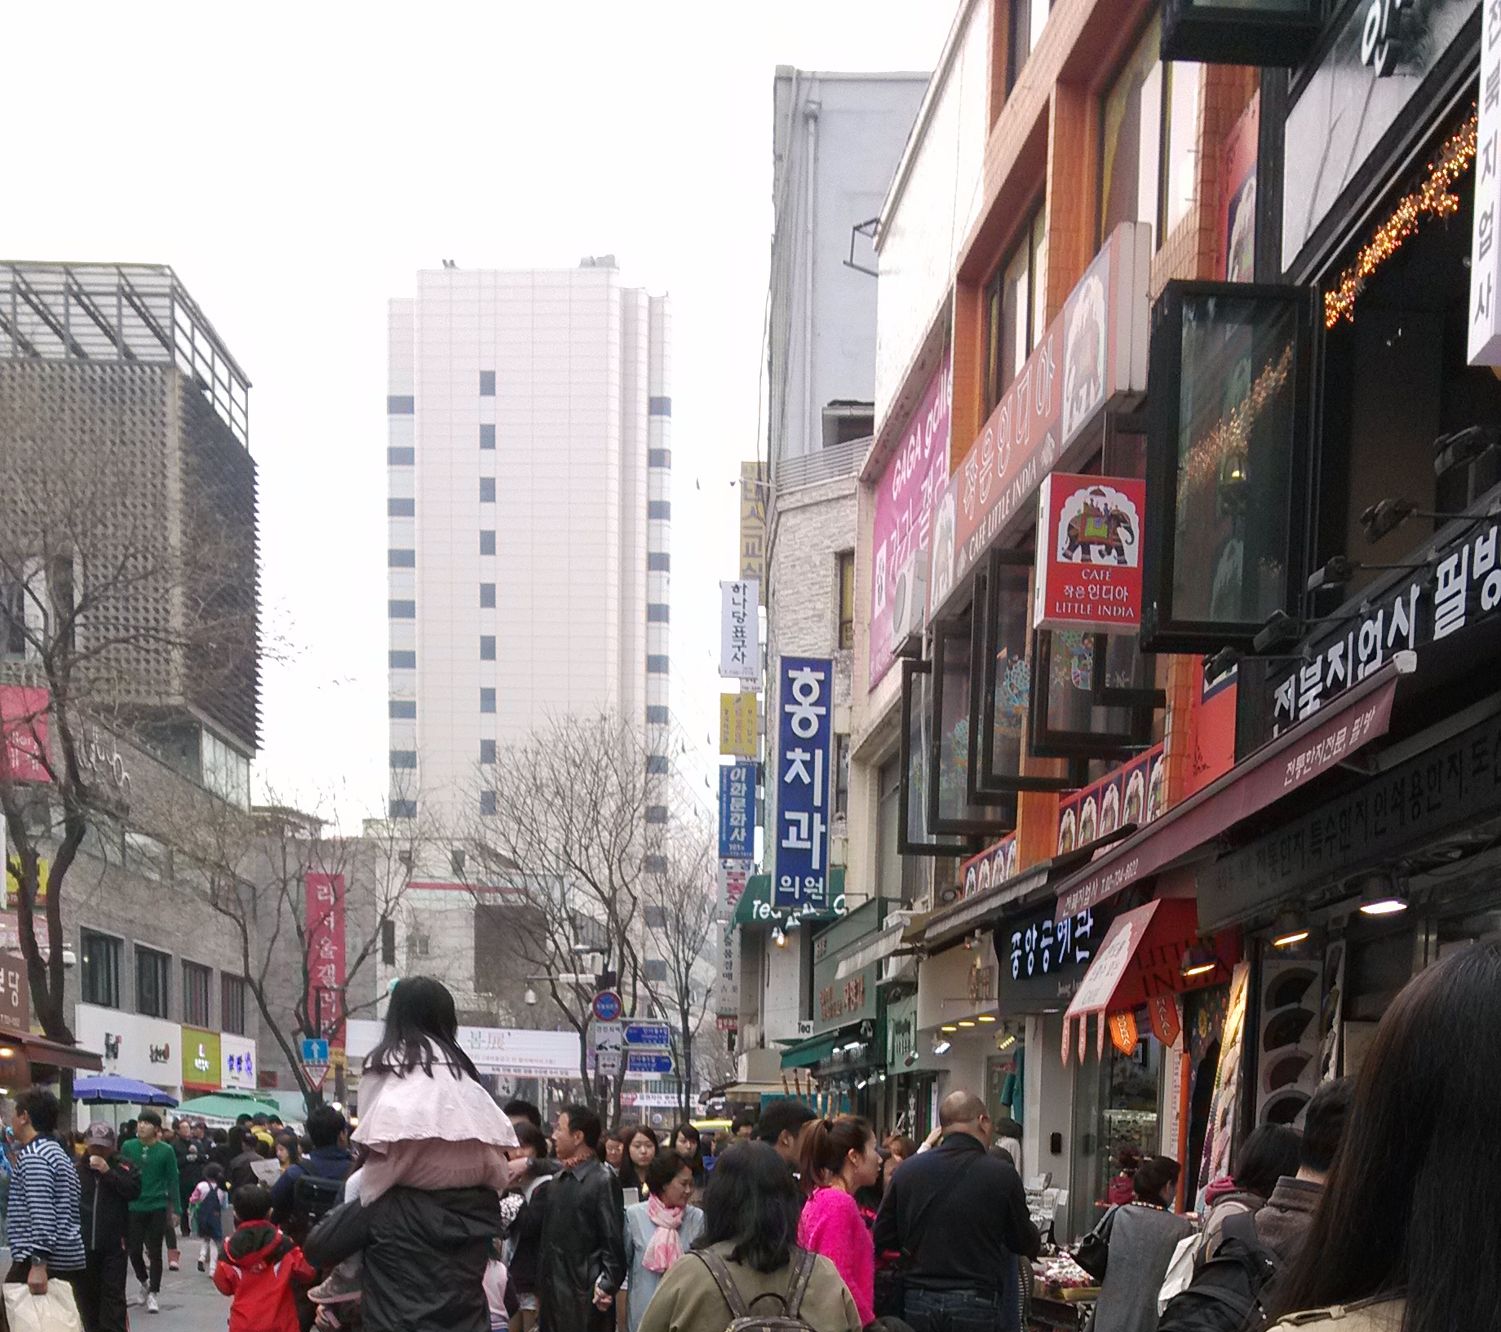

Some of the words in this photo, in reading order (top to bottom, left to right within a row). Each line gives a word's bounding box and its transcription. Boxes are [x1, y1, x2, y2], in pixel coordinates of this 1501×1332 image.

[891, 423, 922, 500] GAGA
[987, 494, 1009, 537] LITTLE
[1010, 456, 1037, 503] INDIA
[1056, 602, 1093, 616] LITTLE
[1097, 603, 1135, 618] INDIA
[783, 666, 827, 871] 홍치과
[779, 875, 824, 902] 의원
